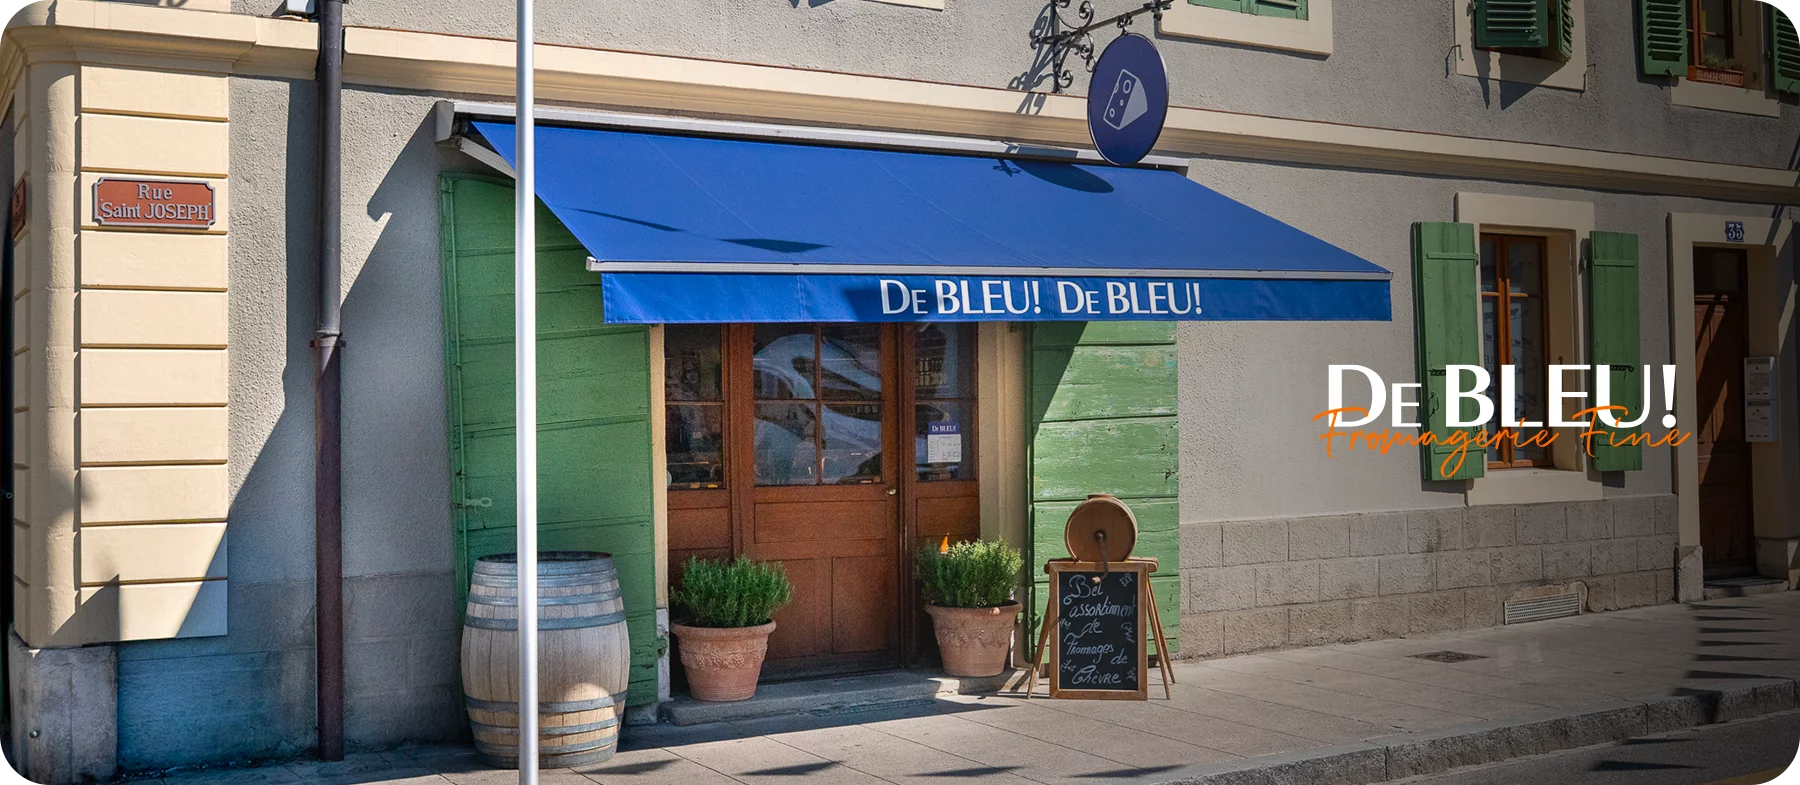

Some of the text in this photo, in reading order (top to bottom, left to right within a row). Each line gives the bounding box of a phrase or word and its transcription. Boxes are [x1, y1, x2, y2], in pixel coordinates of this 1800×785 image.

[137, 184, 173, 200] Rue
[101, 202, 210, 220] Saint JOSEPH
[1728, 223, 1743, 240] 35
[935, 280, 1041, 314] BLEU!
[1107, 282, 1202, 315] BLEU!
[1063, 574, 1104, 606] Bel
[1082, 618, 1103, 635] de
[1064, 633, 1128, 665] Fromages de
